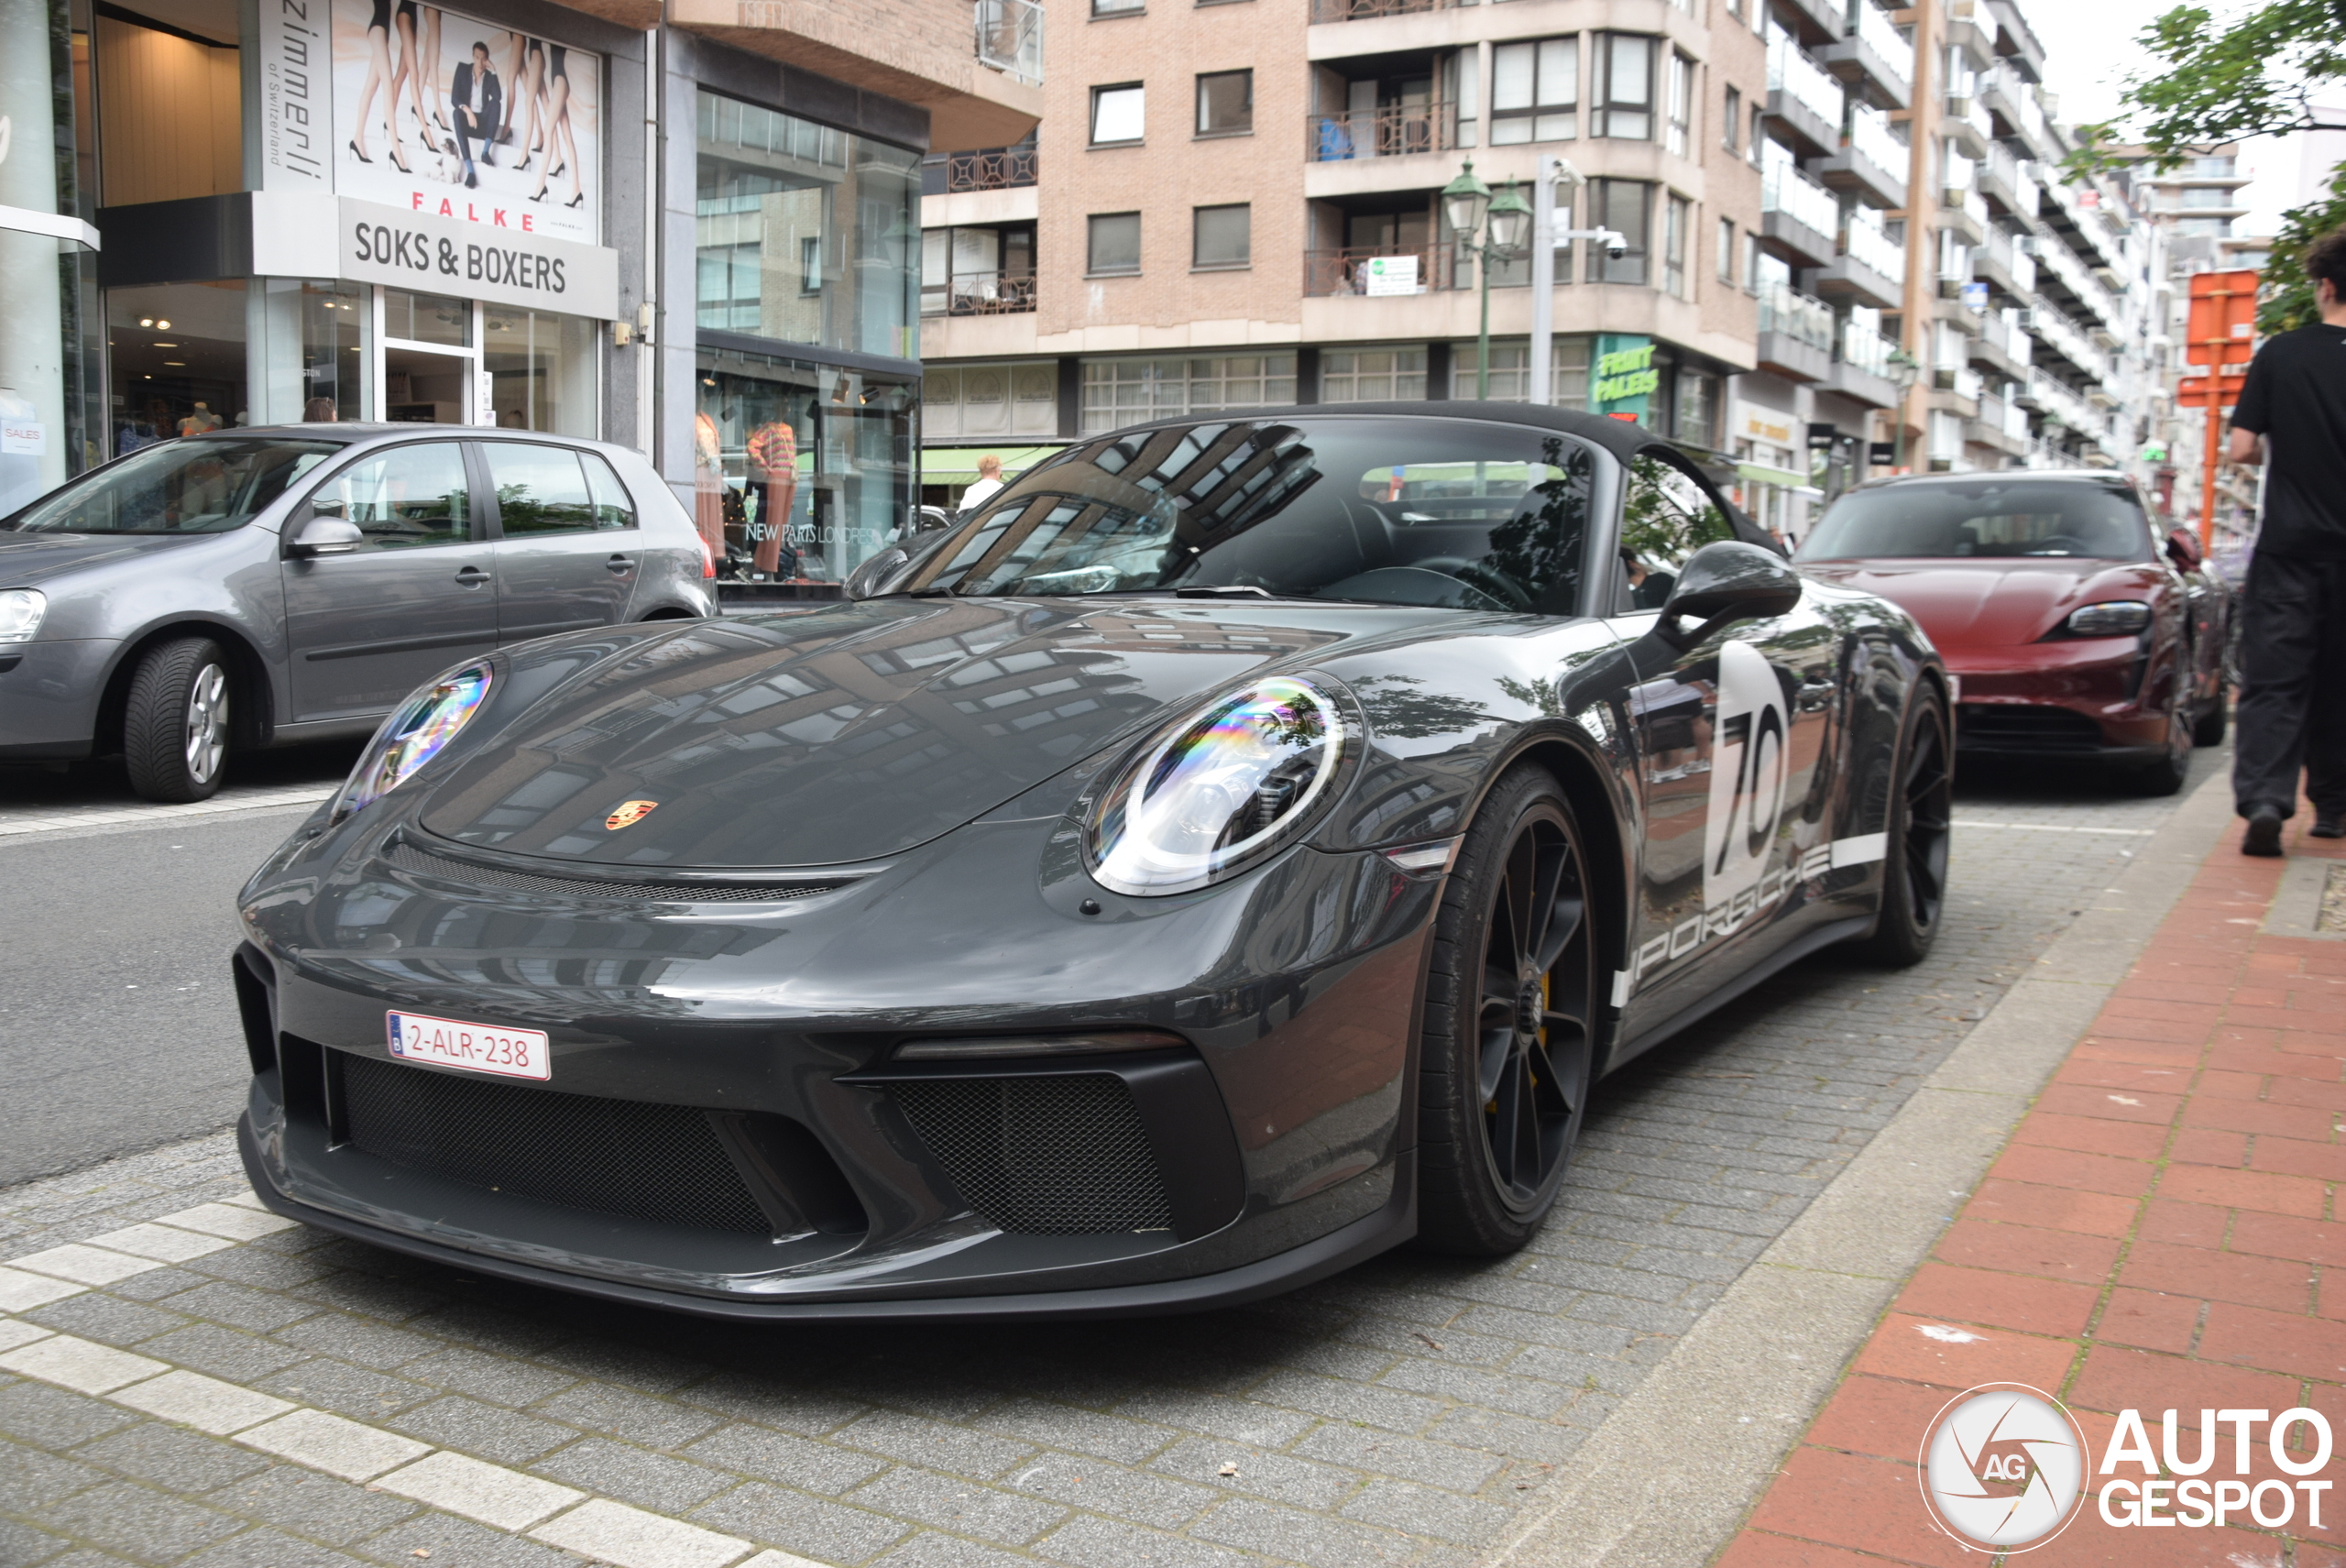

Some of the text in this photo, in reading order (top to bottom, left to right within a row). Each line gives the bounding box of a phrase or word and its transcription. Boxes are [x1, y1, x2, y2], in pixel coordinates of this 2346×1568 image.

[282, 0, 322, 180] zimmerli
[269, 62, 281, 167] of Switzerland
[411, 191, 533, 232] FALKE
[355, 222, 565, 293] SOKS & BOXERS
[1598, 345, 1657, 377] FRUIT
[1593, 368, 1659, 403] PALEIS
[5, 428, 40, 440] SALES
[745, 522, 875, 544] NEW PARIS LONDRES
[1713, 703, 1782, 877] 70
[1635, 842, 1832, 981] PORSCHE
[392, 1036, 401, 1052] B
[411, 1025, 530, 1068] 2-ALR-238
